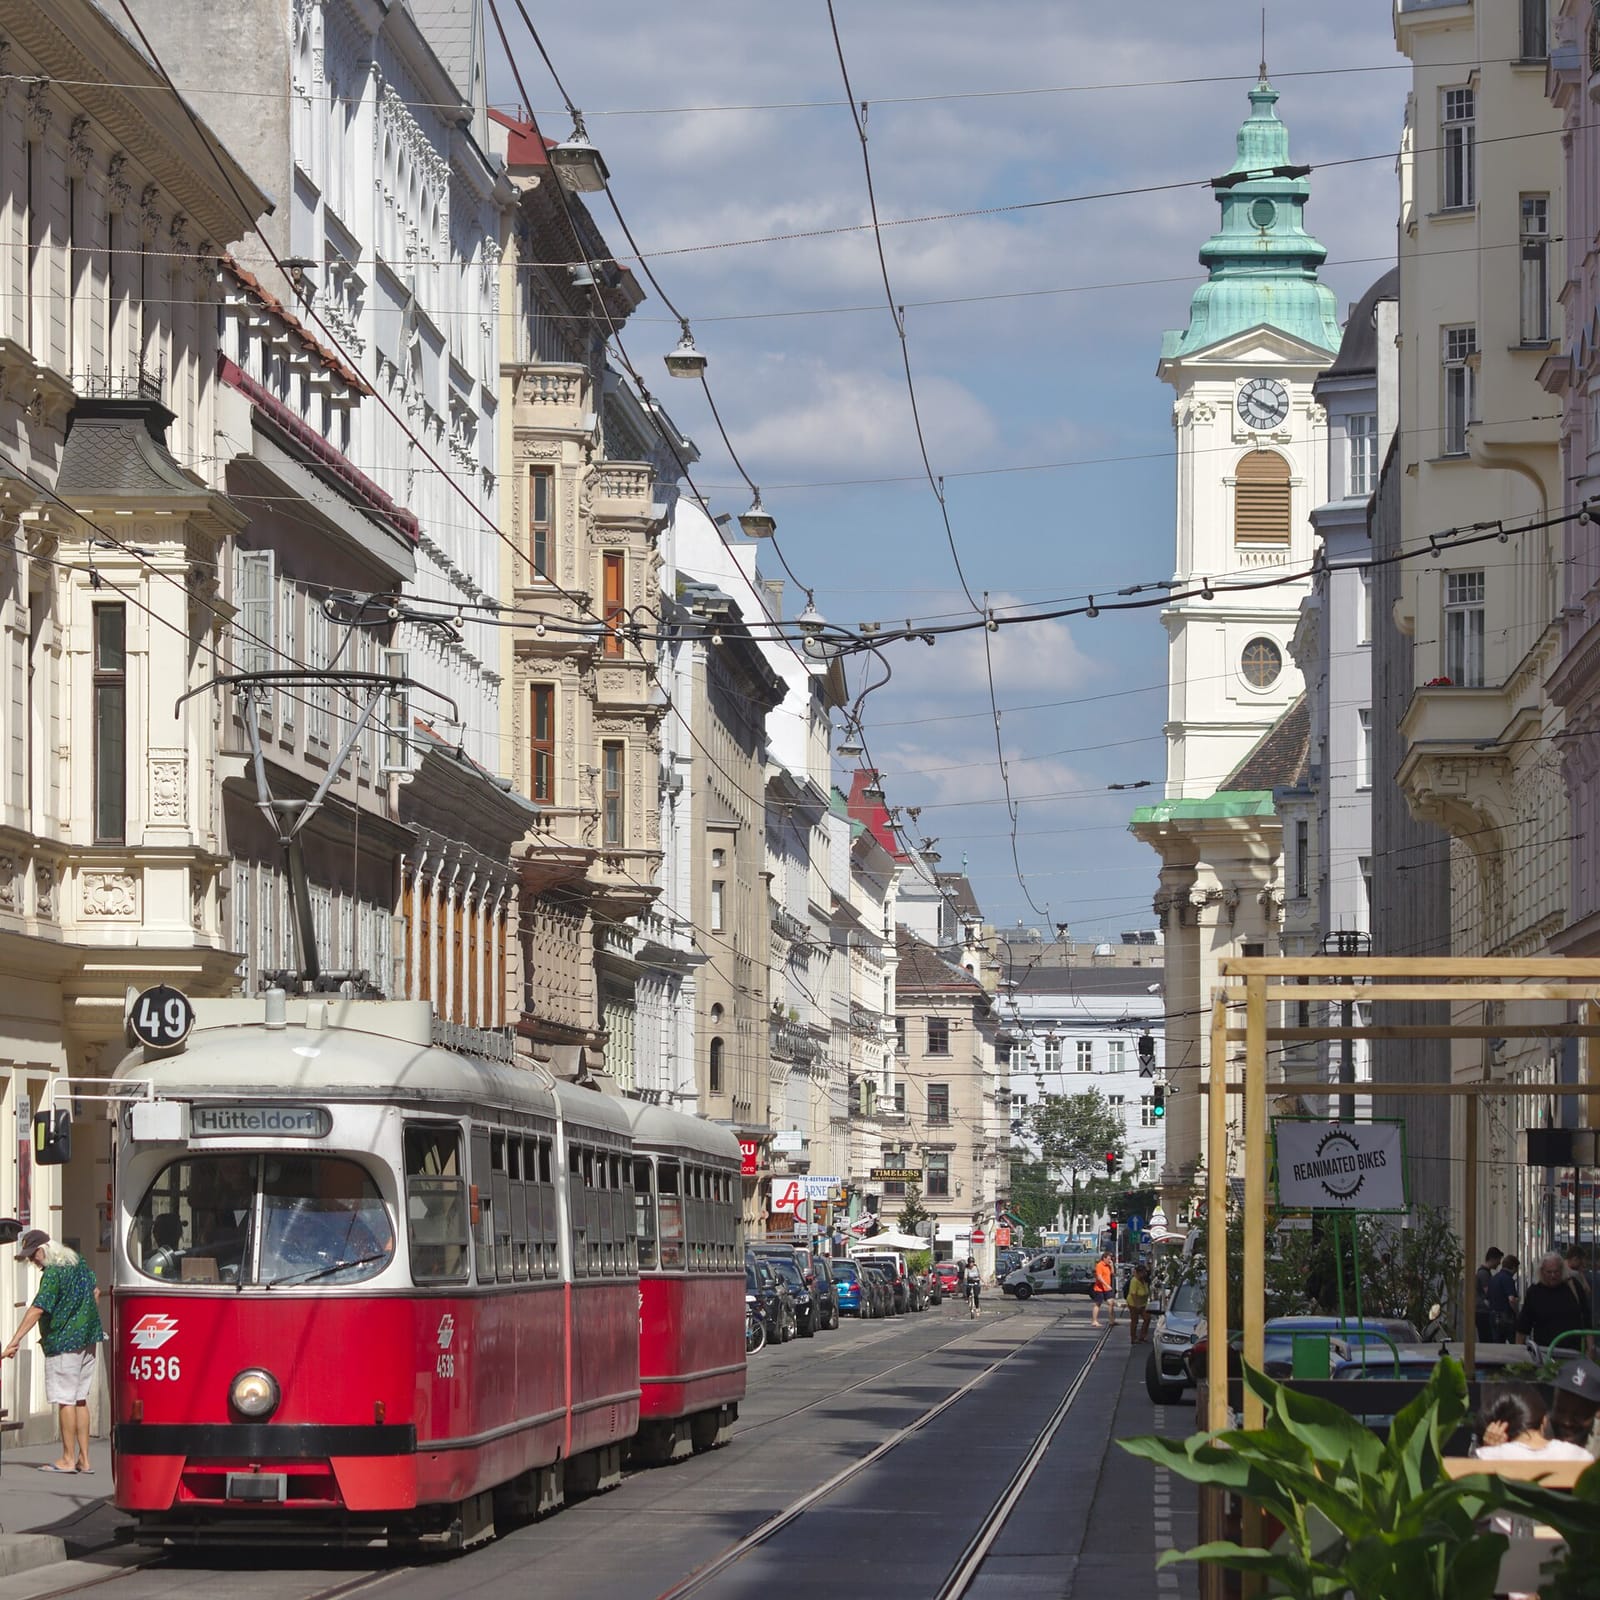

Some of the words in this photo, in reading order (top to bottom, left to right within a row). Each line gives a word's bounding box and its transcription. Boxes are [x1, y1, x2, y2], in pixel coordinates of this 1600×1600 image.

[139, 997, 186, 1038] 49
[201, 1110, 314, 1129] Hütteldorf
[873, 1169, 919, 1177] TIMELESS
[1293, 1155, 1356, 1182] REANIMATED
[1357, 1149, 1387, 1171] BIKES
[129, 1355, 181, 1382] 4536
[436, 1354, 455, 1379] 4536
